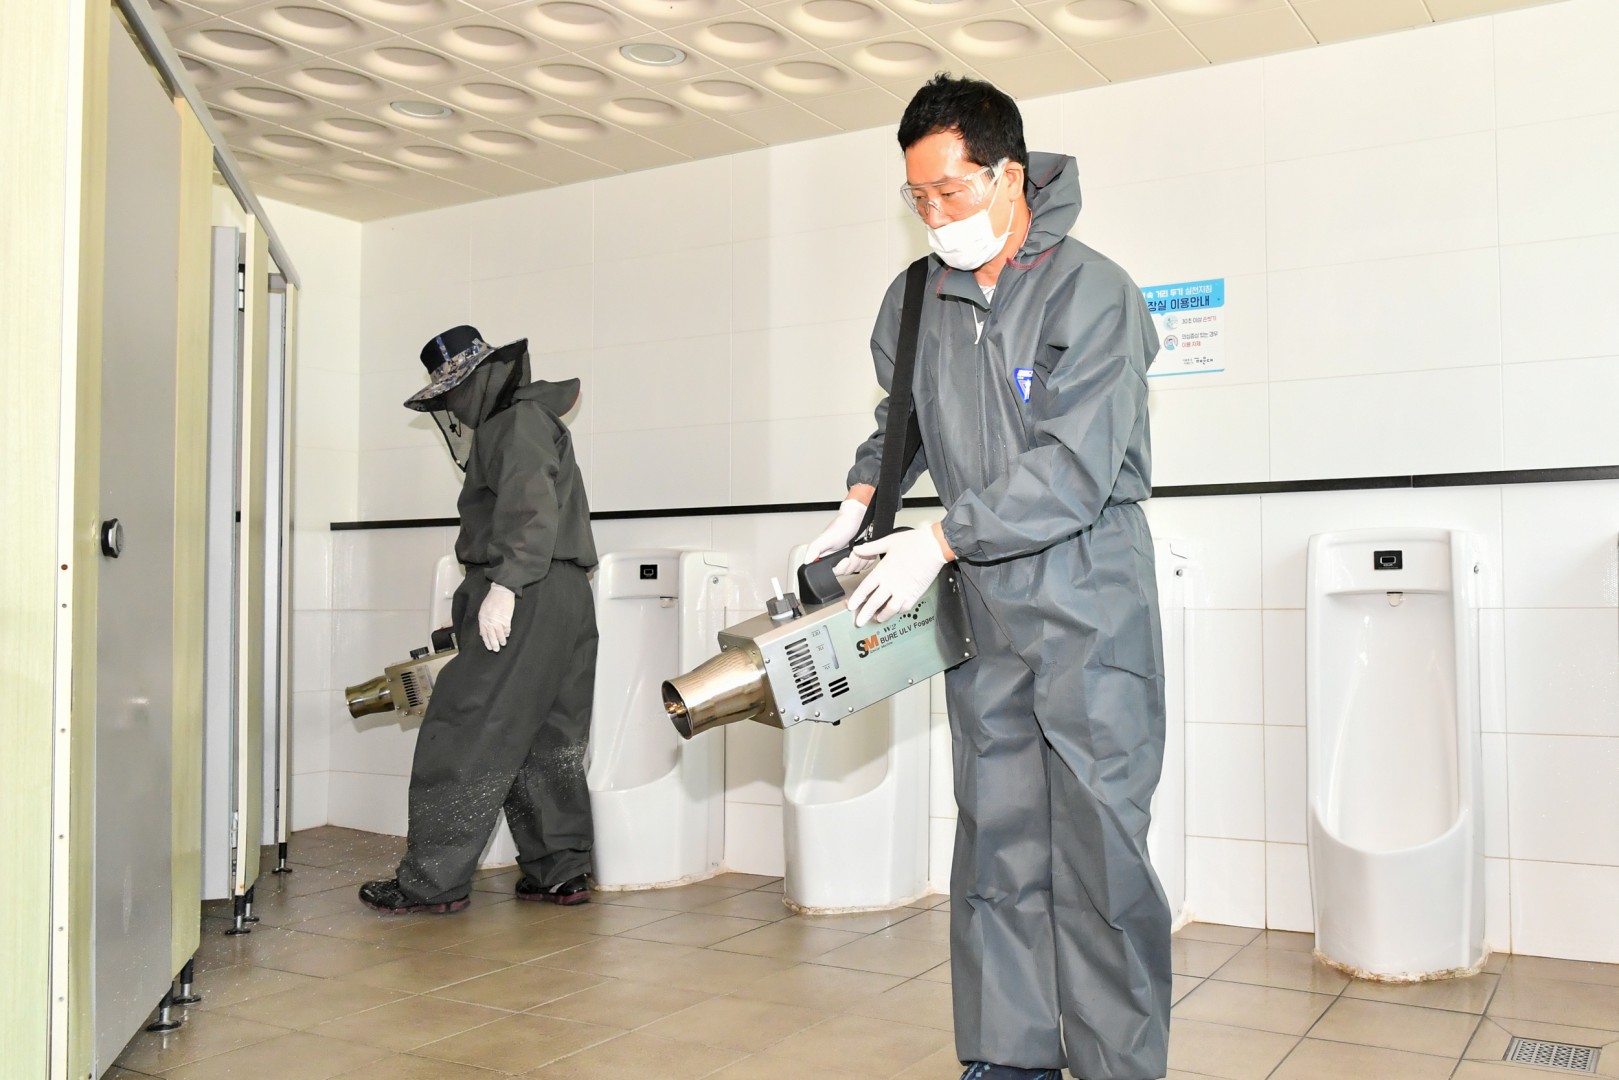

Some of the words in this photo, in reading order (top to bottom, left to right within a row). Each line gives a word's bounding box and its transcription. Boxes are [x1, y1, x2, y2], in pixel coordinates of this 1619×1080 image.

[1147, 300, 1167, 312] 장실
[1170, 295, 1210, 310] 이용안내
[880, 631, 899, 644] BURE
[898, 624, 912, 636] ULV
[913, 615, 935, 629] Fogger
[856, 633, 880, 658] SM
